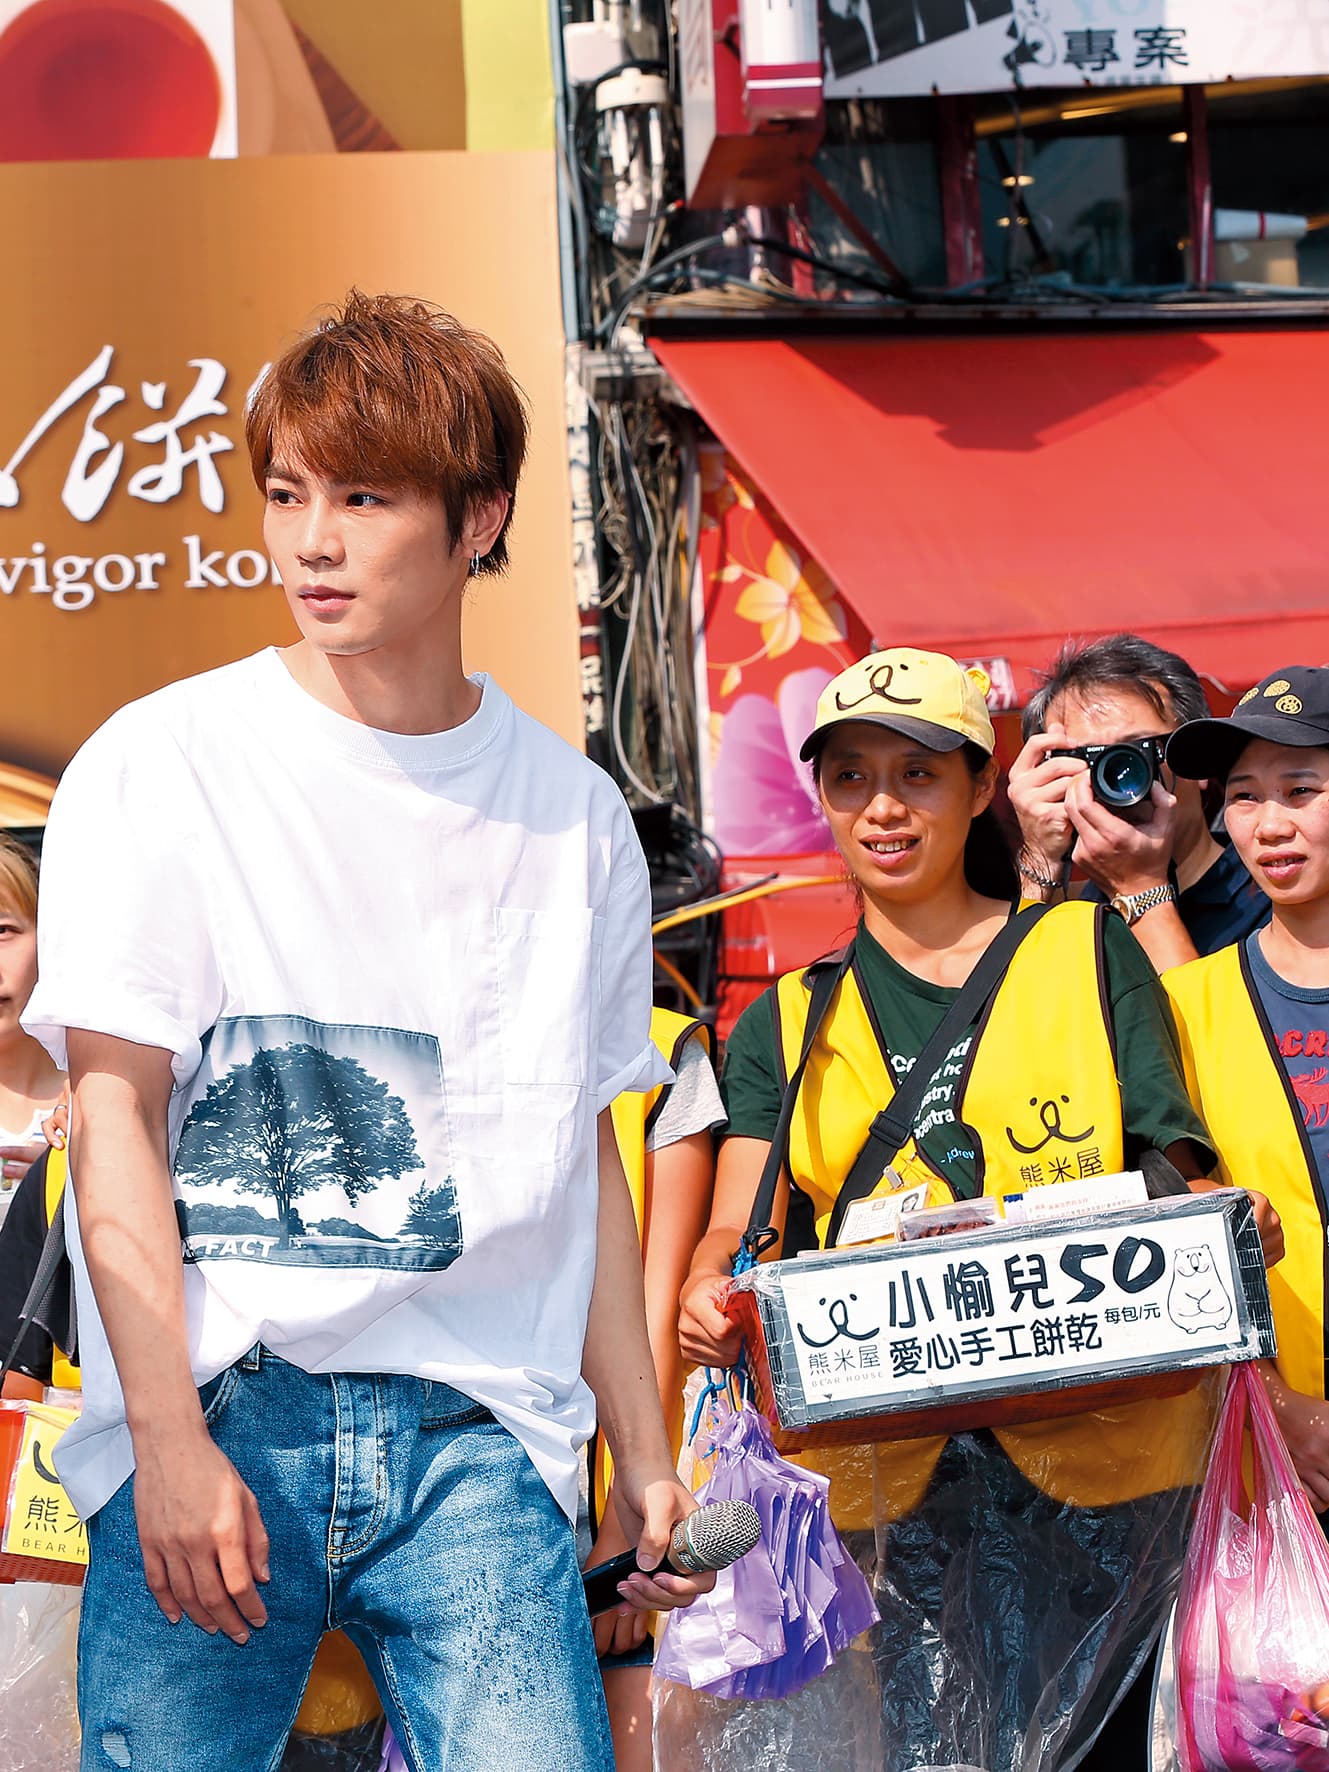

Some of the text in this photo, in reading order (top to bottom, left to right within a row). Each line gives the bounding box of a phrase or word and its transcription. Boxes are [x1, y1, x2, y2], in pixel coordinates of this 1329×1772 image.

[1063, 24, 1189, 71] 專案
[182, 534, 284, 588] ko
[1020, 1147, 1104, 1189] 熊米屋
[205, 1238, 280, 1258] FACT
[888, 1235, 1167, 1329] 小愉兒 50
[808, 1344, 881, 1376] 熊米屋
[889, 1312, 1103, 1378] 愛心手工餅乾
[811, 1371, 884, 1388] BEAR HOUSE
[22, 1537, 67, 1553] BEAR
